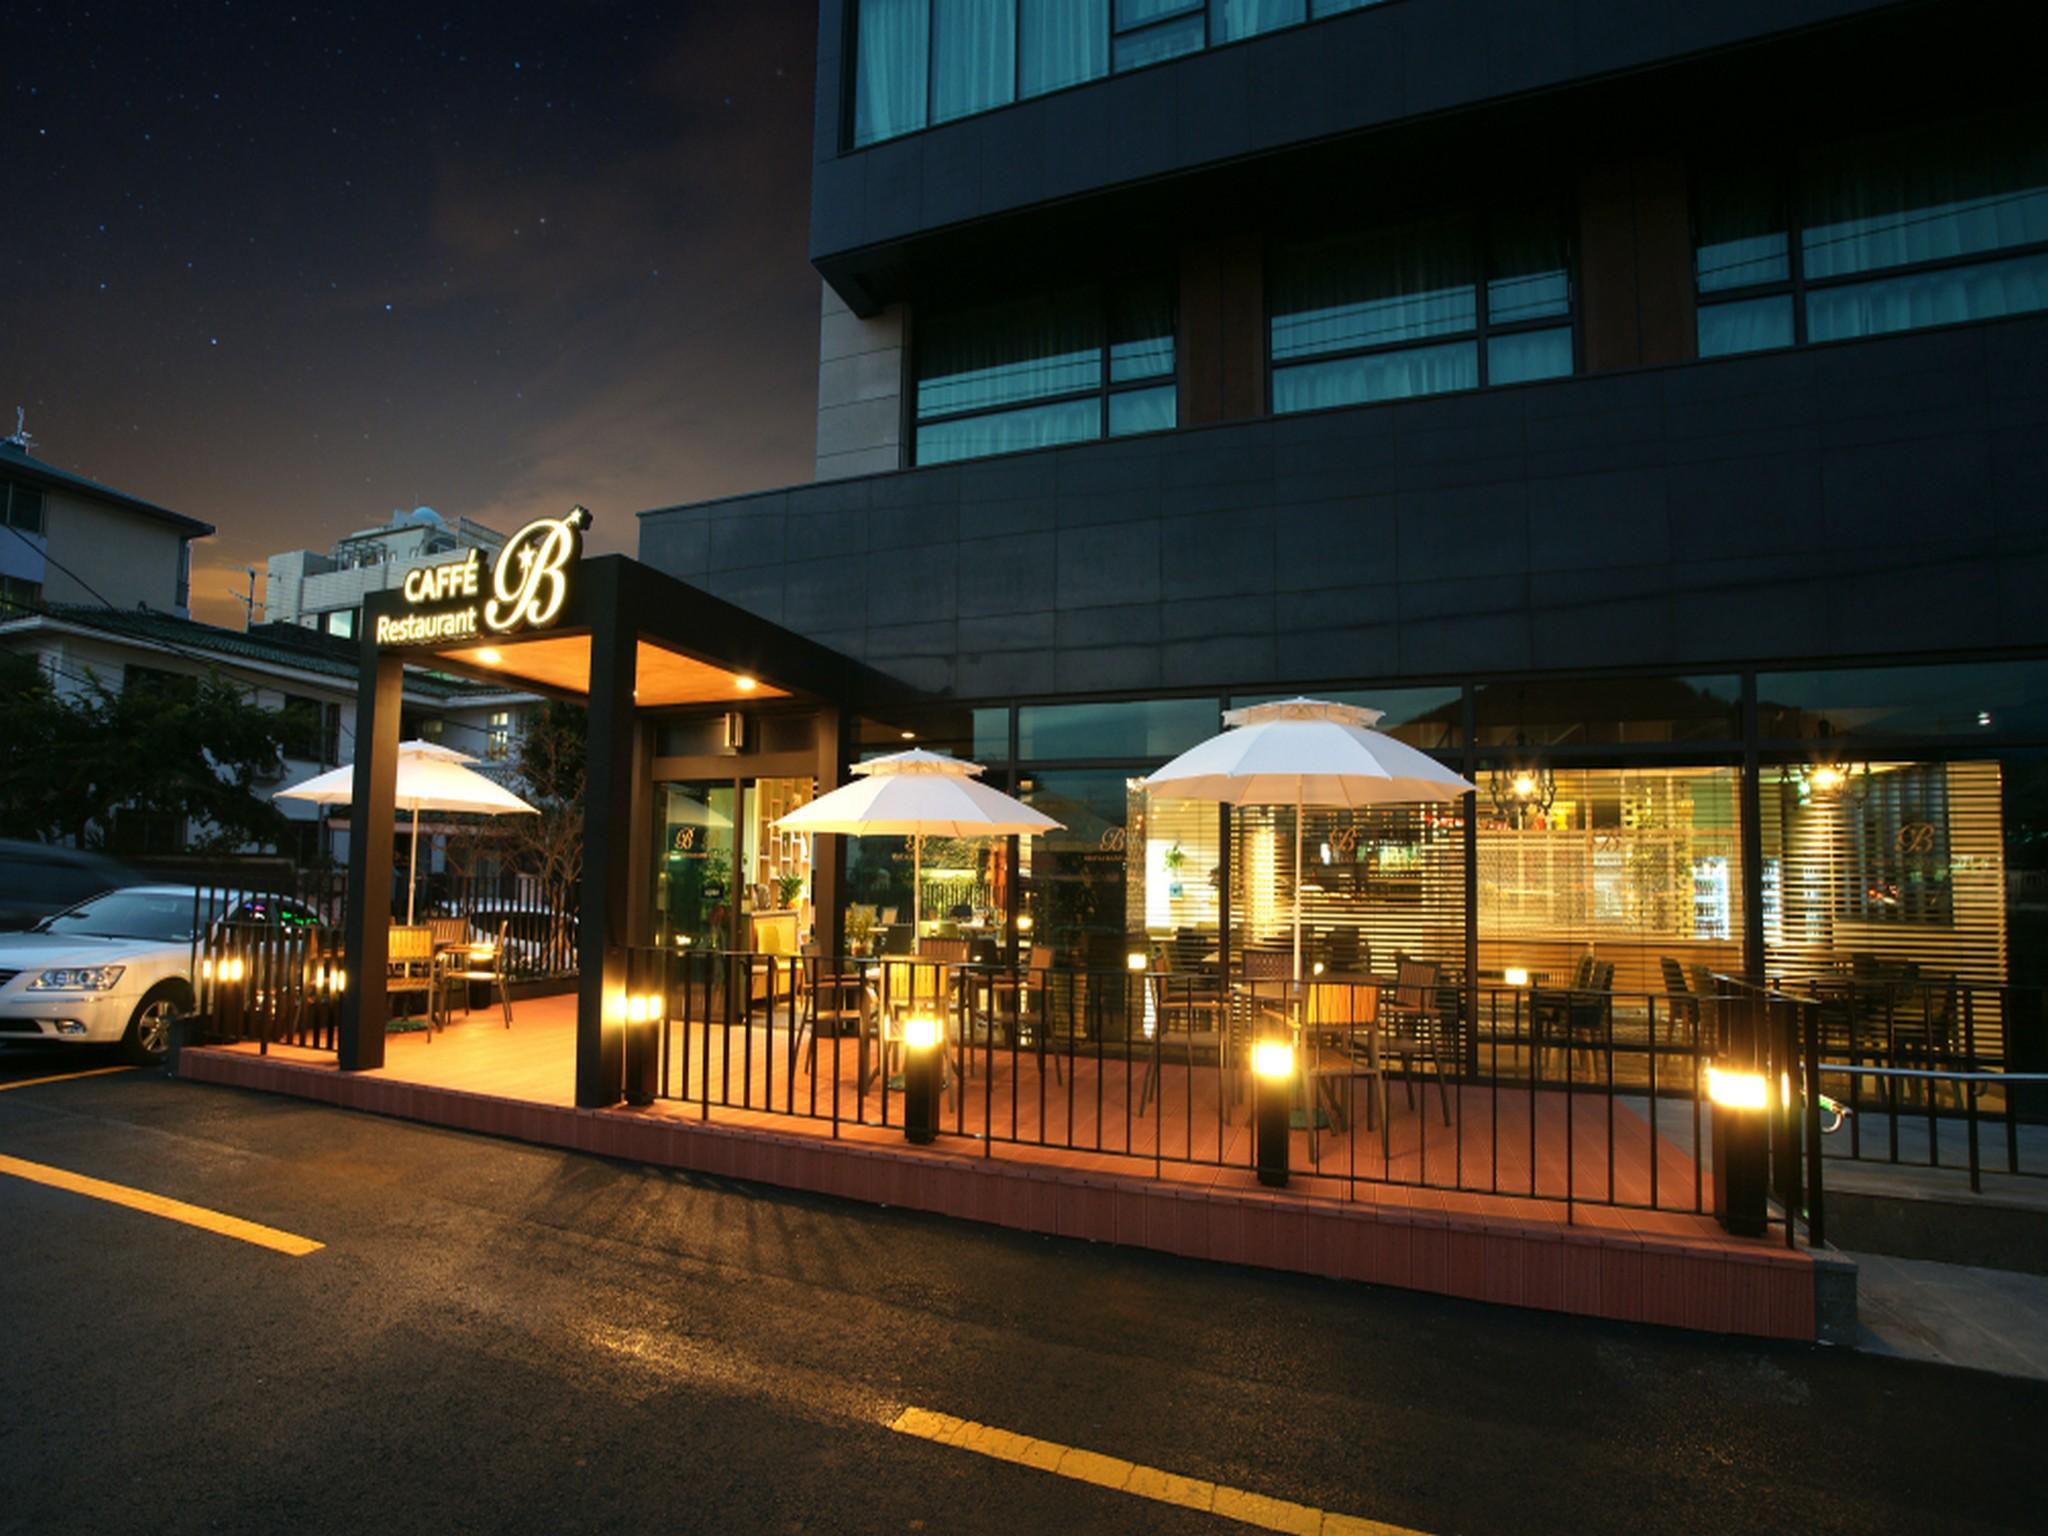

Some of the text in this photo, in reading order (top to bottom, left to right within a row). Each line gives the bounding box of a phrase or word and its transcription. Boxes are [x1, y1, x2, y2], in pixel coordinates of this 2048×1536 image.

[404, 547, 479, 602] CAFFÉ
[484, 516, 574, 631] B
[376, 605, 479, 644] Restaurant
